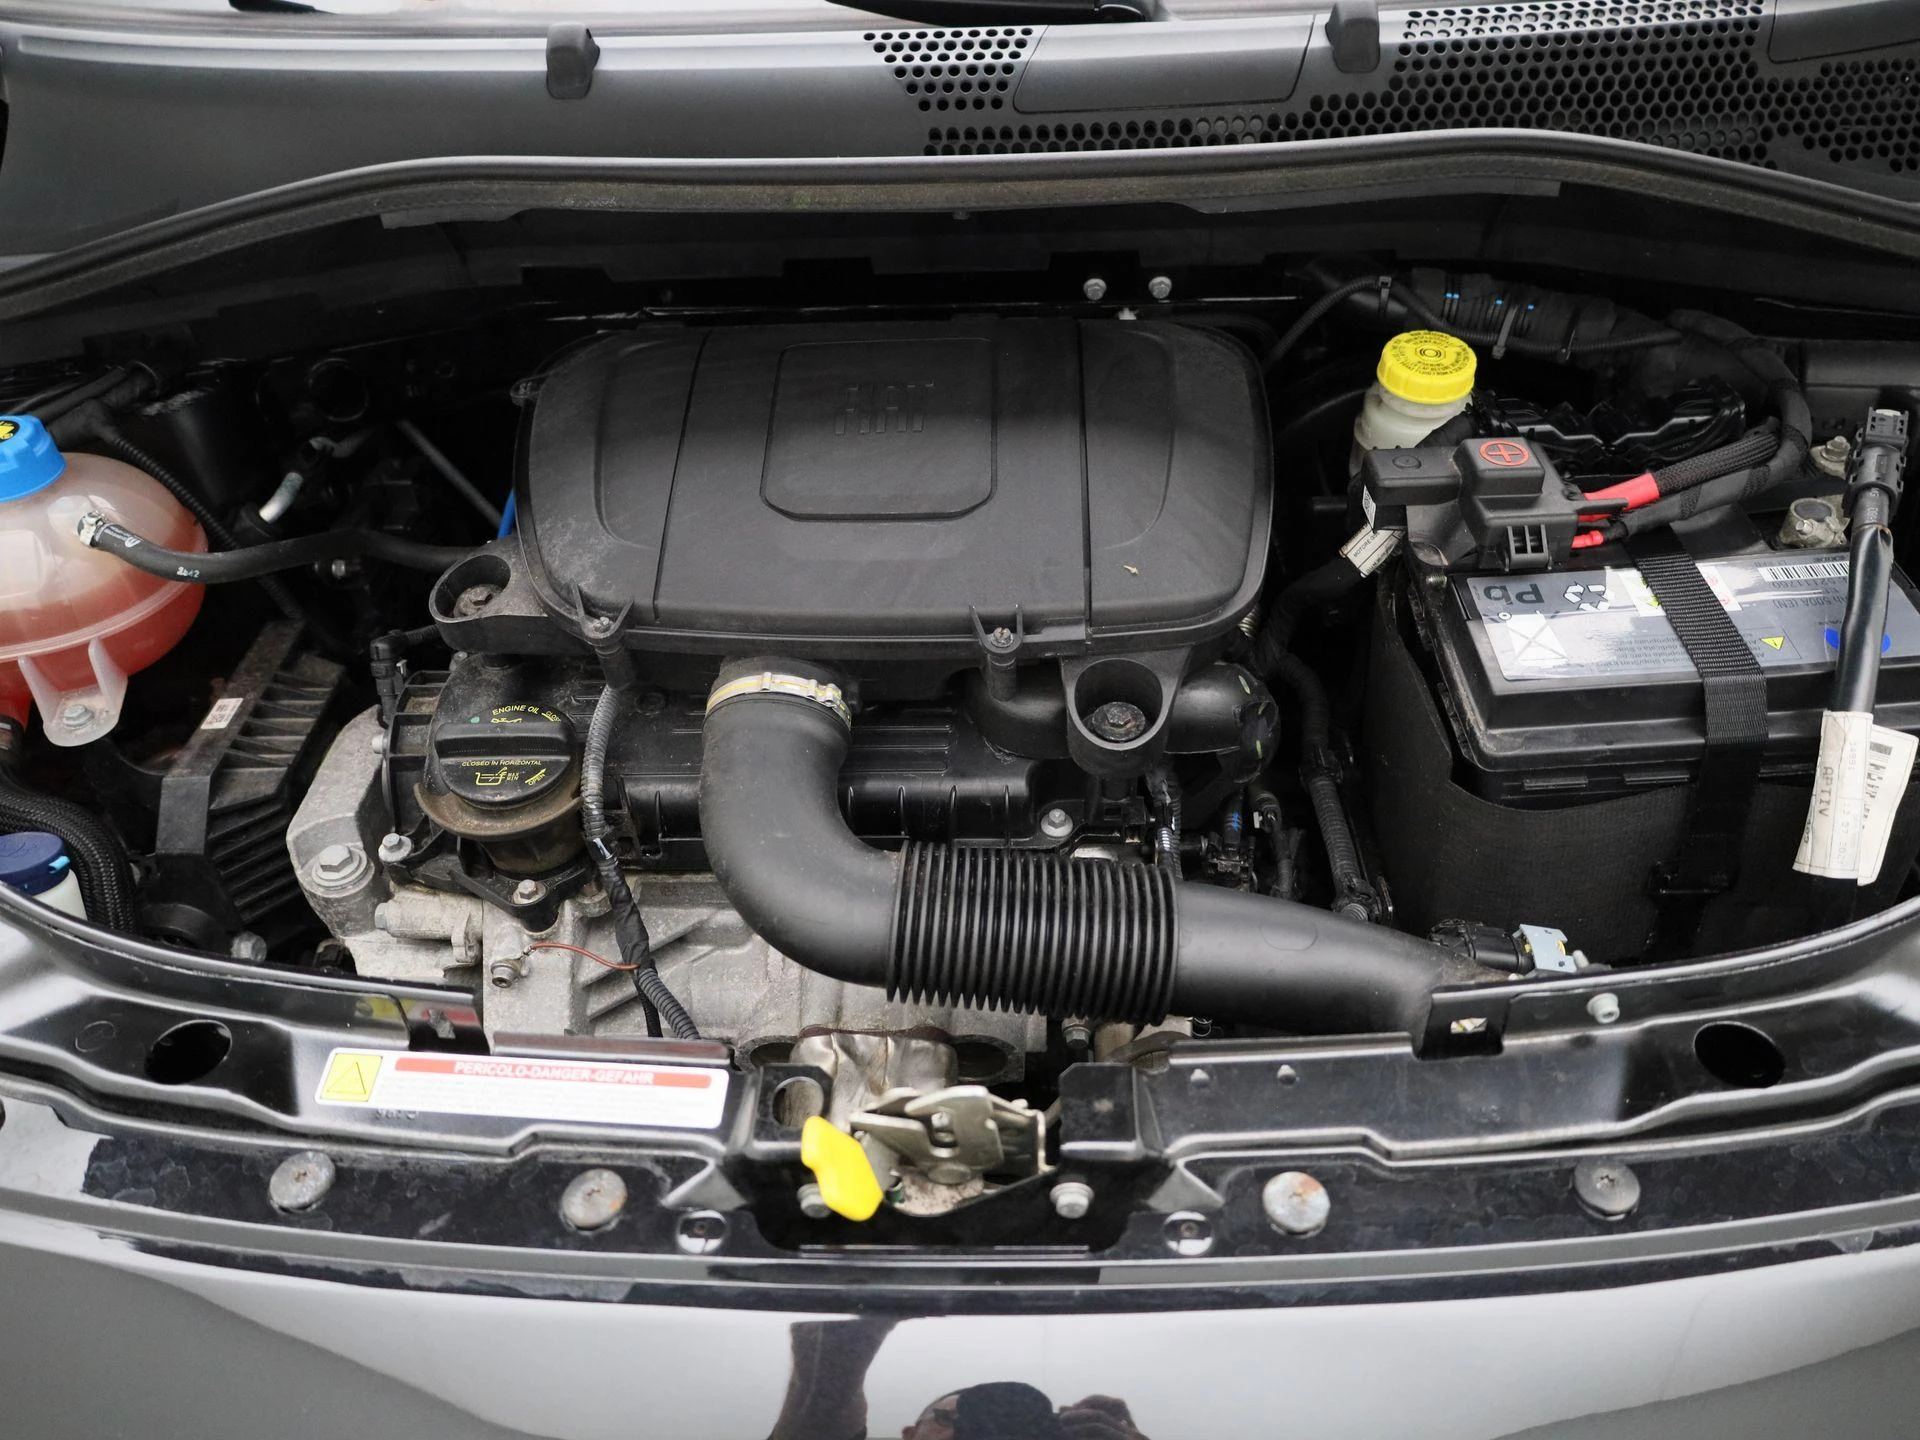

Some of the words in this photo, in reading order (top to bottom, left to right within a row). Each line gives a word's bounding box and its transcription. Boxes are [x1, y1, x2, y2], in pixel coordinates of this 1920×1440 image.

[1483, 583, 1545, 606] Pb
[1772, 598, 1799, 610] (EN)
[491, 704, 527, 716] ENGINE
[527, 705, 540, 715] OIL
[528, 773, 546, 786] OPEN
[1818, 765, 1835, 818] APTIV
[454, 1060, 655, 1086] PERICOLO-DANGER-GEFAHR
